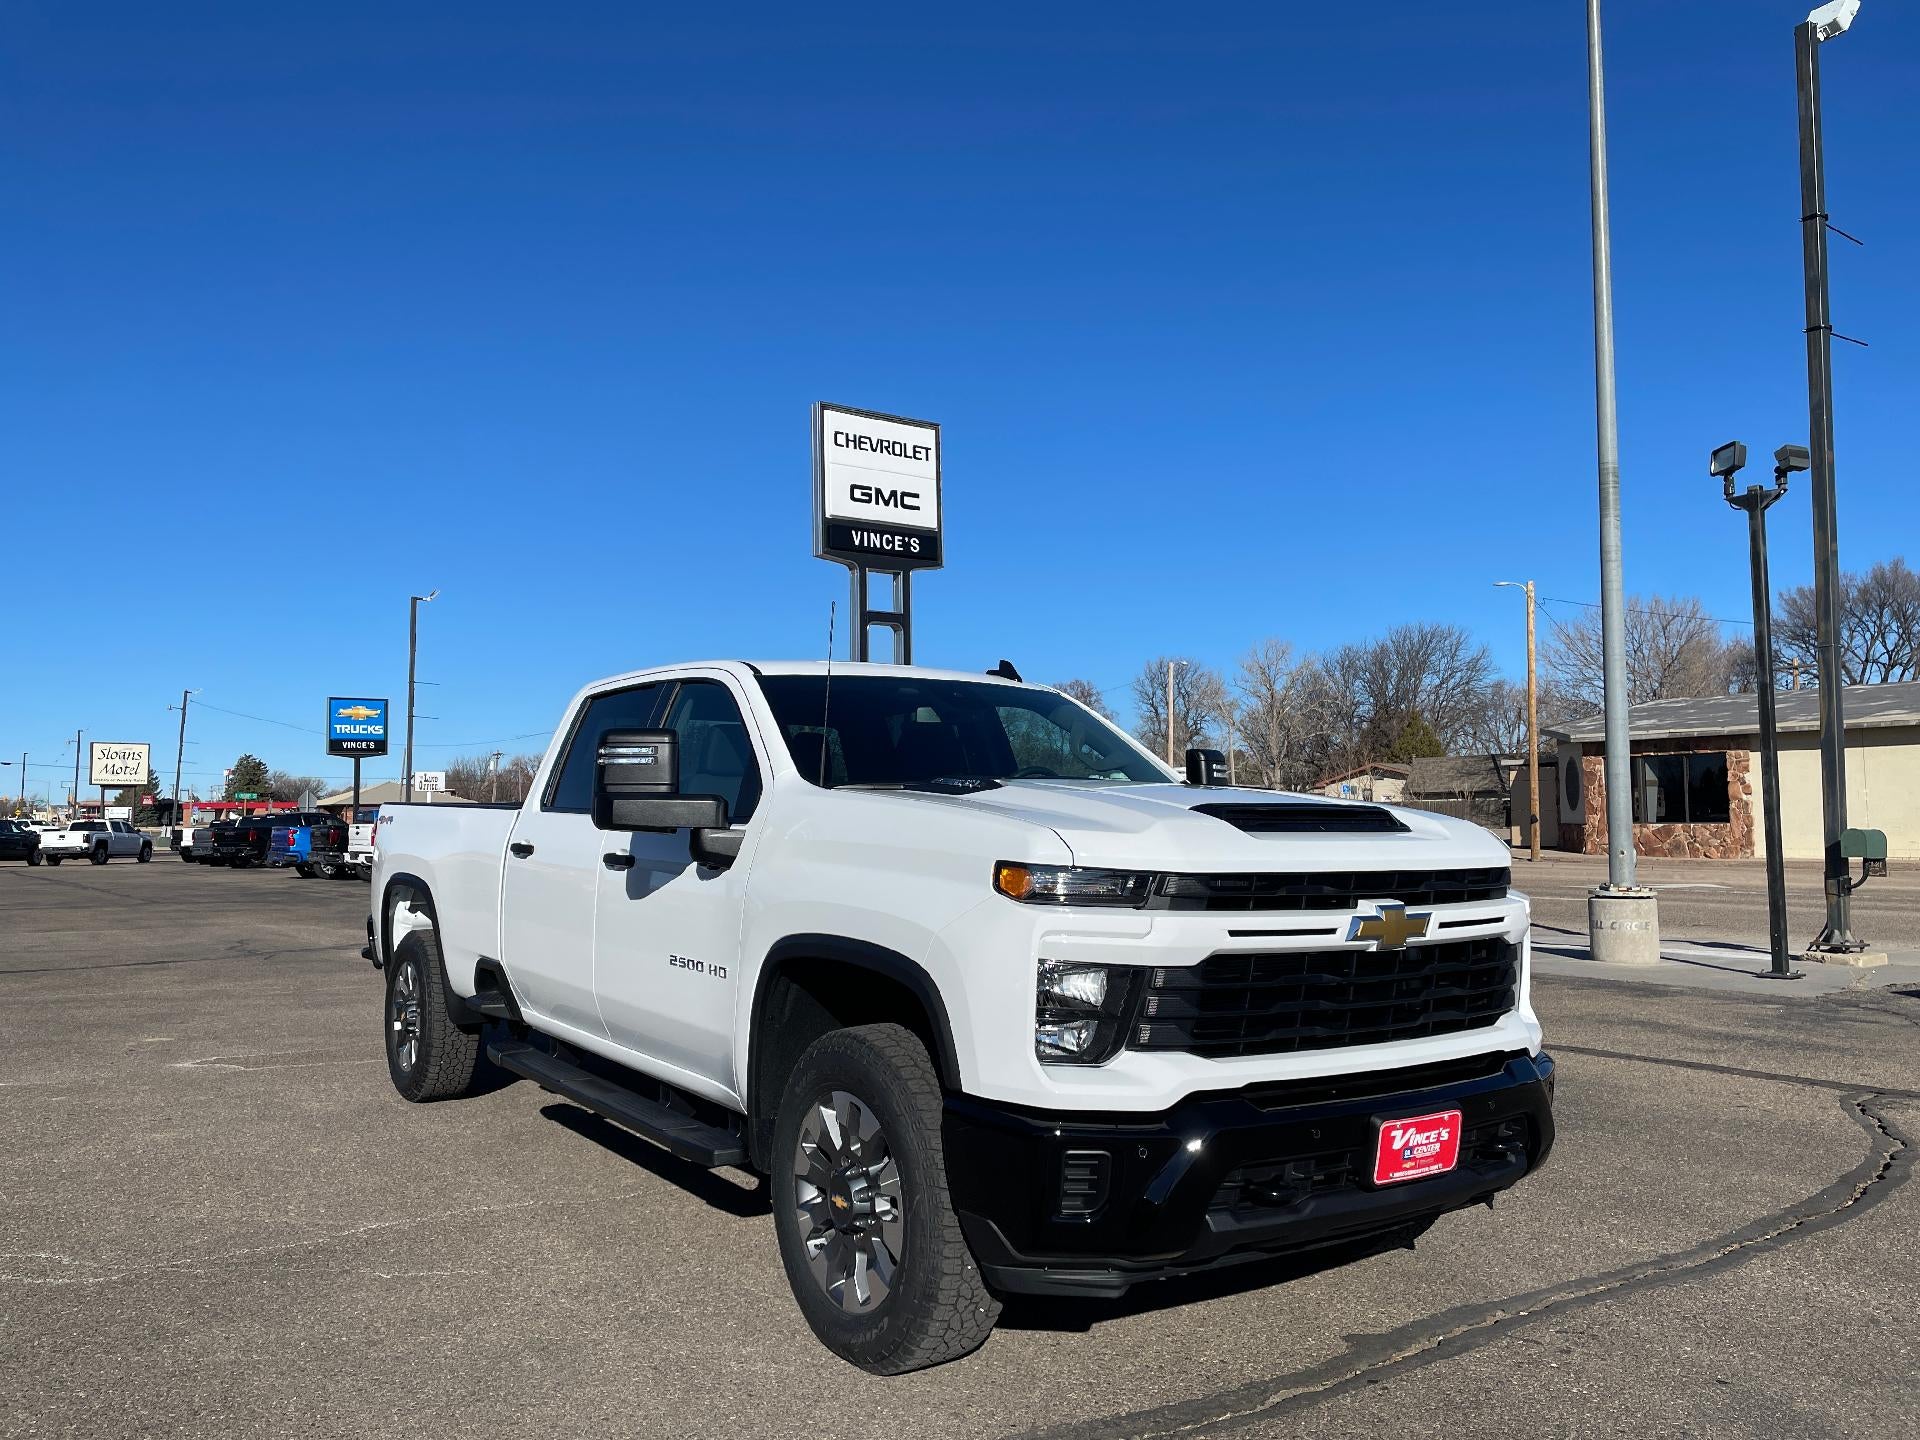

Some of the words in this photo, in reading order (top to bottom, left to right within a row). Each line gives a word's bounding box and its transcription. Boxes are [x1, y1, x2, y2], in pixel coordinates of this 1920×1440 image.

[833, 430, 932, 462] CHEVROLET
[849, 483, 921, 511] GMC
[851, 529, 920, 553] VINCE'S
[333, 724, 384, 735] TRUCKS
[97, 746, 143, 761] Sloans
[342, 741, 375, 749] VINCE'S
[98, 761, 141, 776] Motel
[670, 955, 704, 973] 2500
[708, 964, 727, 979] HD
[1391, 1128, 1450, 1150] VINCE'S
[1414, 1142, 1440, 1155] CENTER
